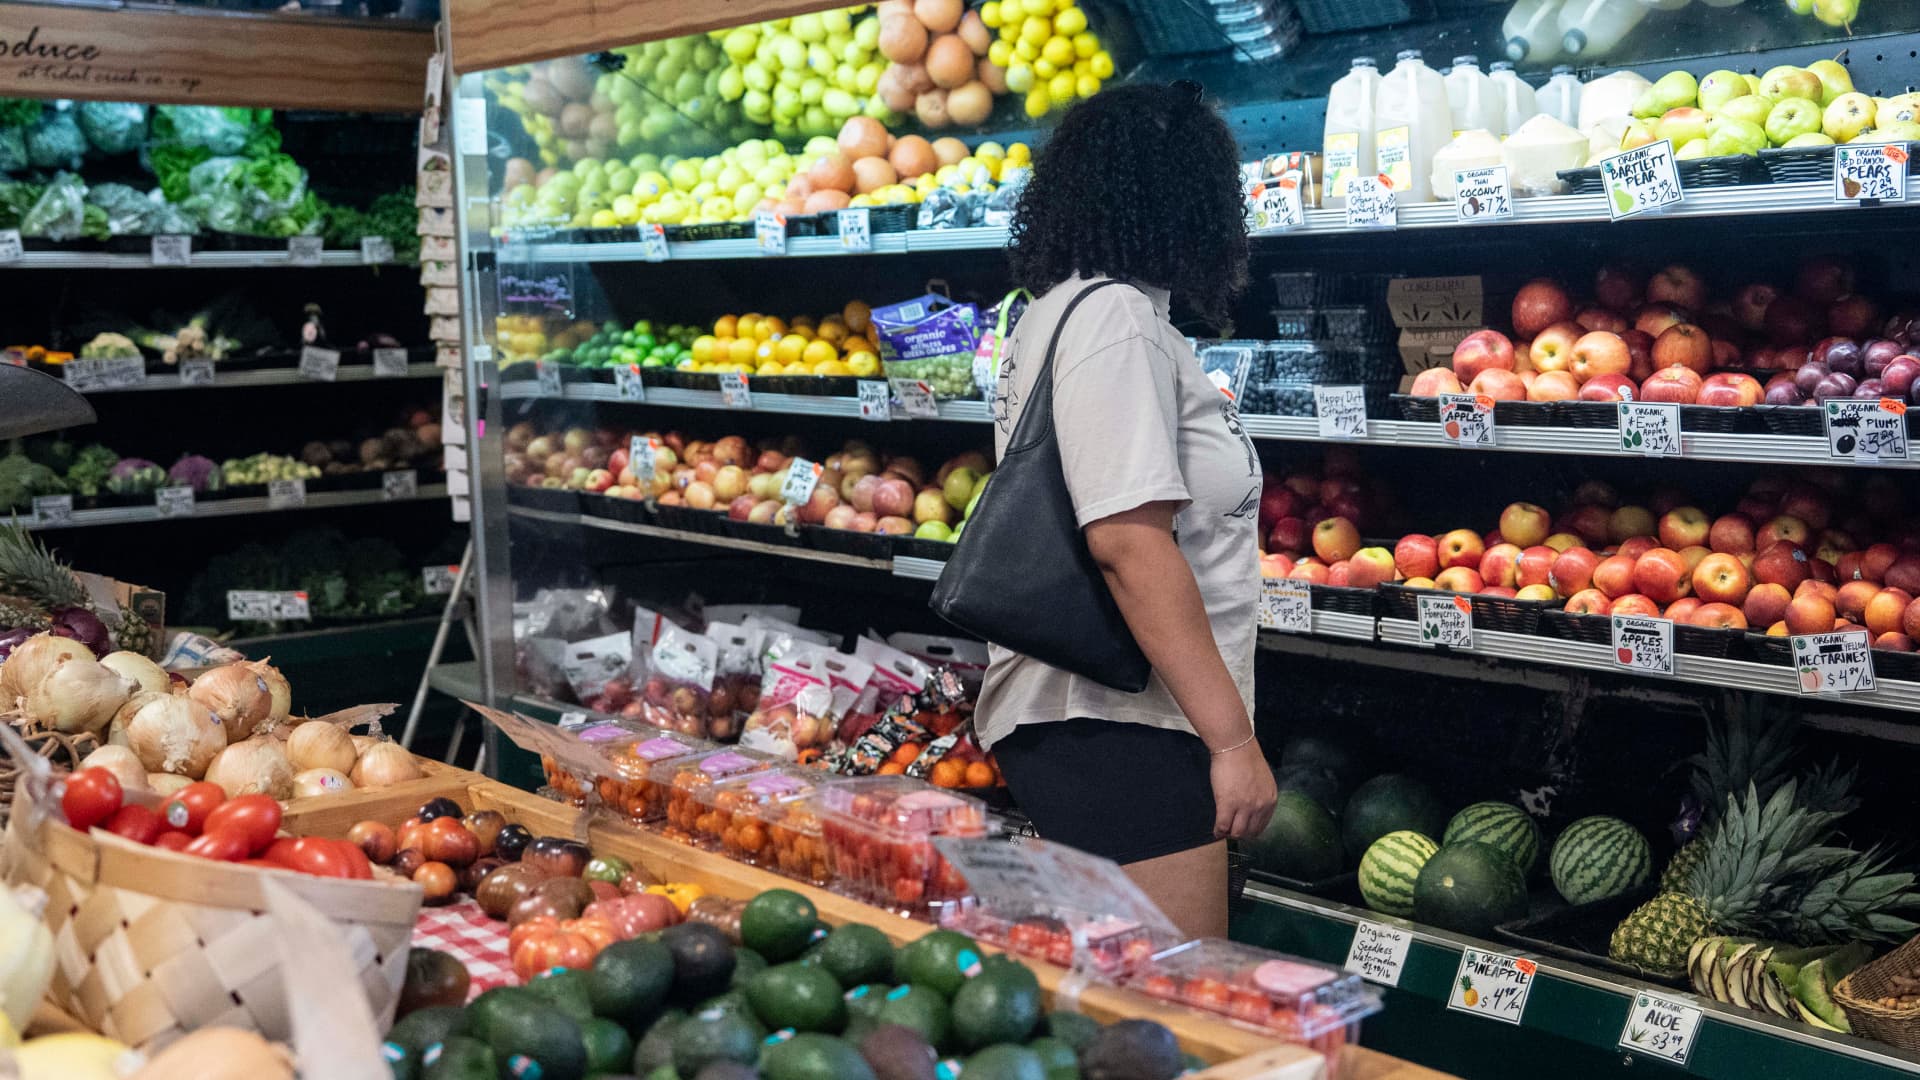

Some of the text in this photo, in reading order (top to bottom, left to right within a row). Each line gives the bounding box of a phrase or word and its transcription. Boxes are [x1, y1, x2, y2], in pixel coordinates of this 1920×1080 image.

[1618, 148, 1651, 165] ORGANIC
[1856, 148, 1884, 157] ORGANI
[1610, 153, 1665, 180] BARTLETT
[1847, 164, 1892, 179] PEARS
[1467, 169, 1494, 178] ORGANIC
[1625, 170, 1657, 188] PEAR
[1460, 186, 1503, 197] COCONUT
[904, 329, 946, 345] organic
[1320, 391, 1344, 407] Happy
[1635, 408, 1664, 416] ORGANIC
[1841, 409, 1861, 420] Red
[1846, 403, 1881, 413] ORGANIC
[1445, 411, 1484, 422] APPLES
[1866, 418, 1899, 429] PLUMS
[1643, 428, 1667, 436] Apples
[1440, 619, 1465, 629] Apples
[1626, 620, 1657, 629] ORGANIC
[1620, 634, 1663, 647] APPLES
[1812, 634, 1847, 645] ORGANIC
[1845, 641, 1866, 651] YELLOW
[1799, 651, 1867, 666] NECTARINES
[1360, 924, 1401, 942] Organic
[1357, 940, 1393, 955] Seedless
[1353, 950, 1397, 967] Watermelon
[1482, 955, 1515, 969] ORGANIC
[1466, 961, 1529, 984] PINEAPPLE
[1654, 1000, 1686, 1013] ORGANIC
[1644, 1009, 1683, 1031] ALOE
